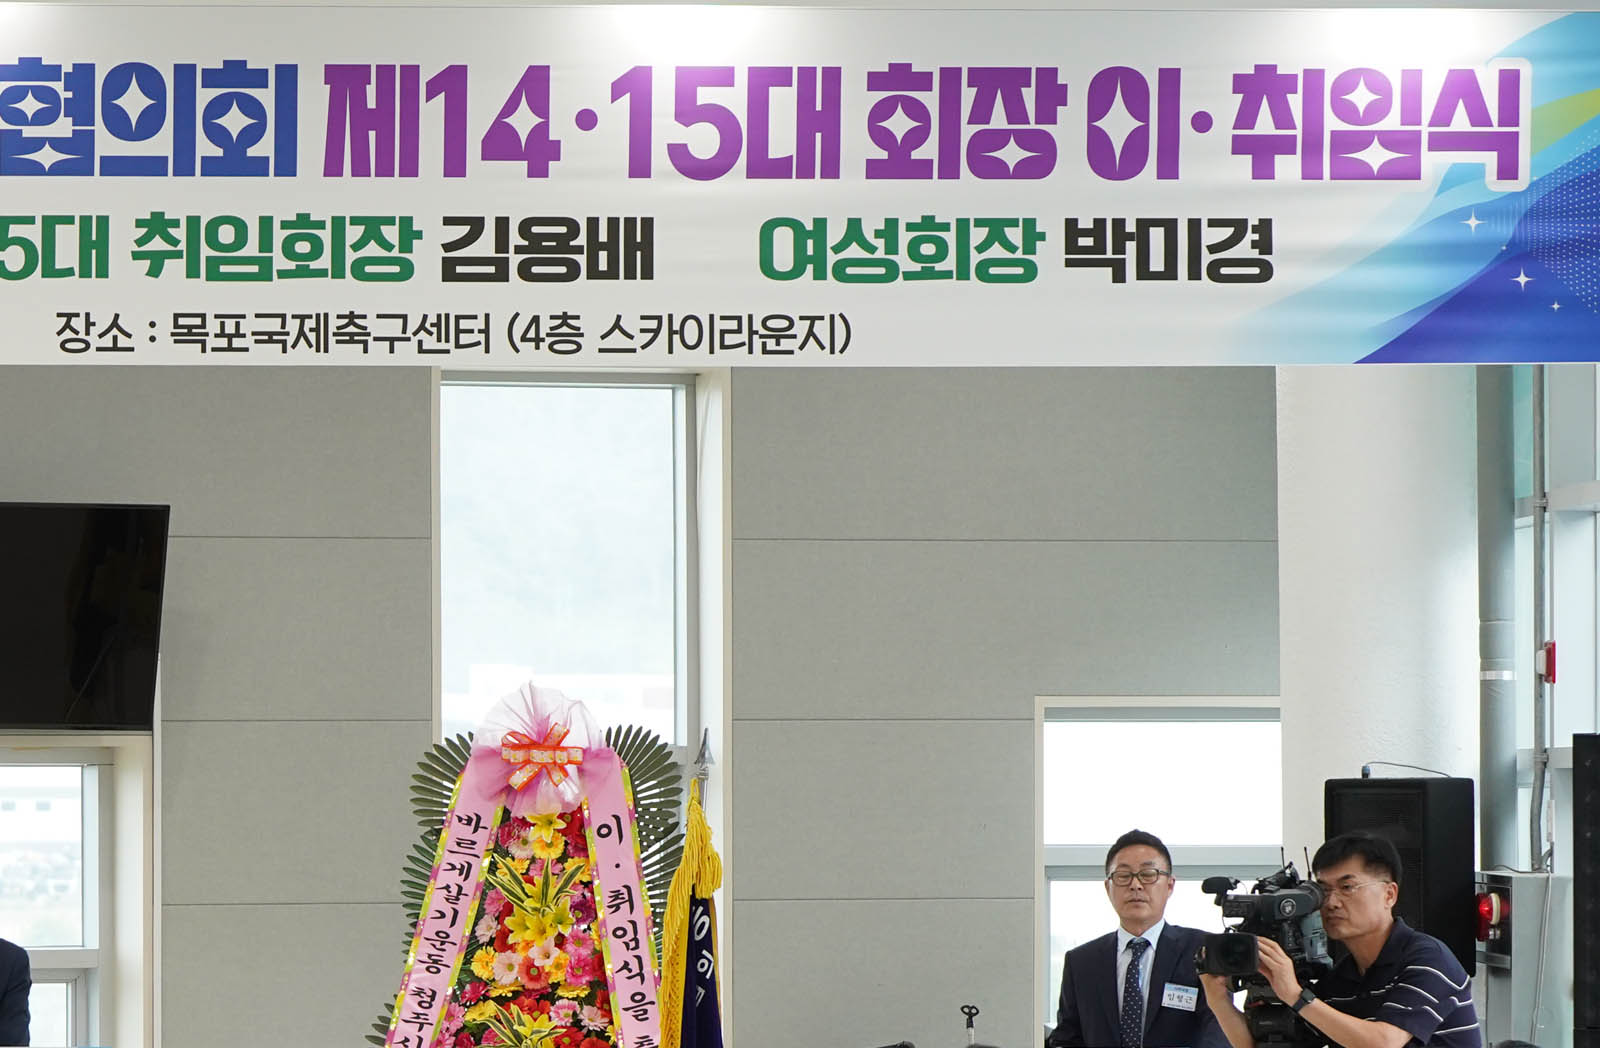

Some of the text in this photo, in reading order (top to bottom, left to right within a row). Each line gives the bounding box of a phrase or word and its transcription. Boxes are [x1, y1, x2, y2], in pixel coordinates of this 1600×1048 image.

[323, 64, 841, 181] 제14·15대
[866, 63, 1068, 181] 회장
[1087, 64, 1520, 181] 이·취임식
[131, 212, 423, 282] 취임회장
[441, 216, 654, 282] 김용배
[760, 215, 1274, 283] 여성회장 박미경
[56, 312, 135, 354] 장소
[170, 311, 491, 354] 목포국제축구센터
[507, 312, 584, 354] (4층
[598, 313, 852, 355] 스카이라운지)
